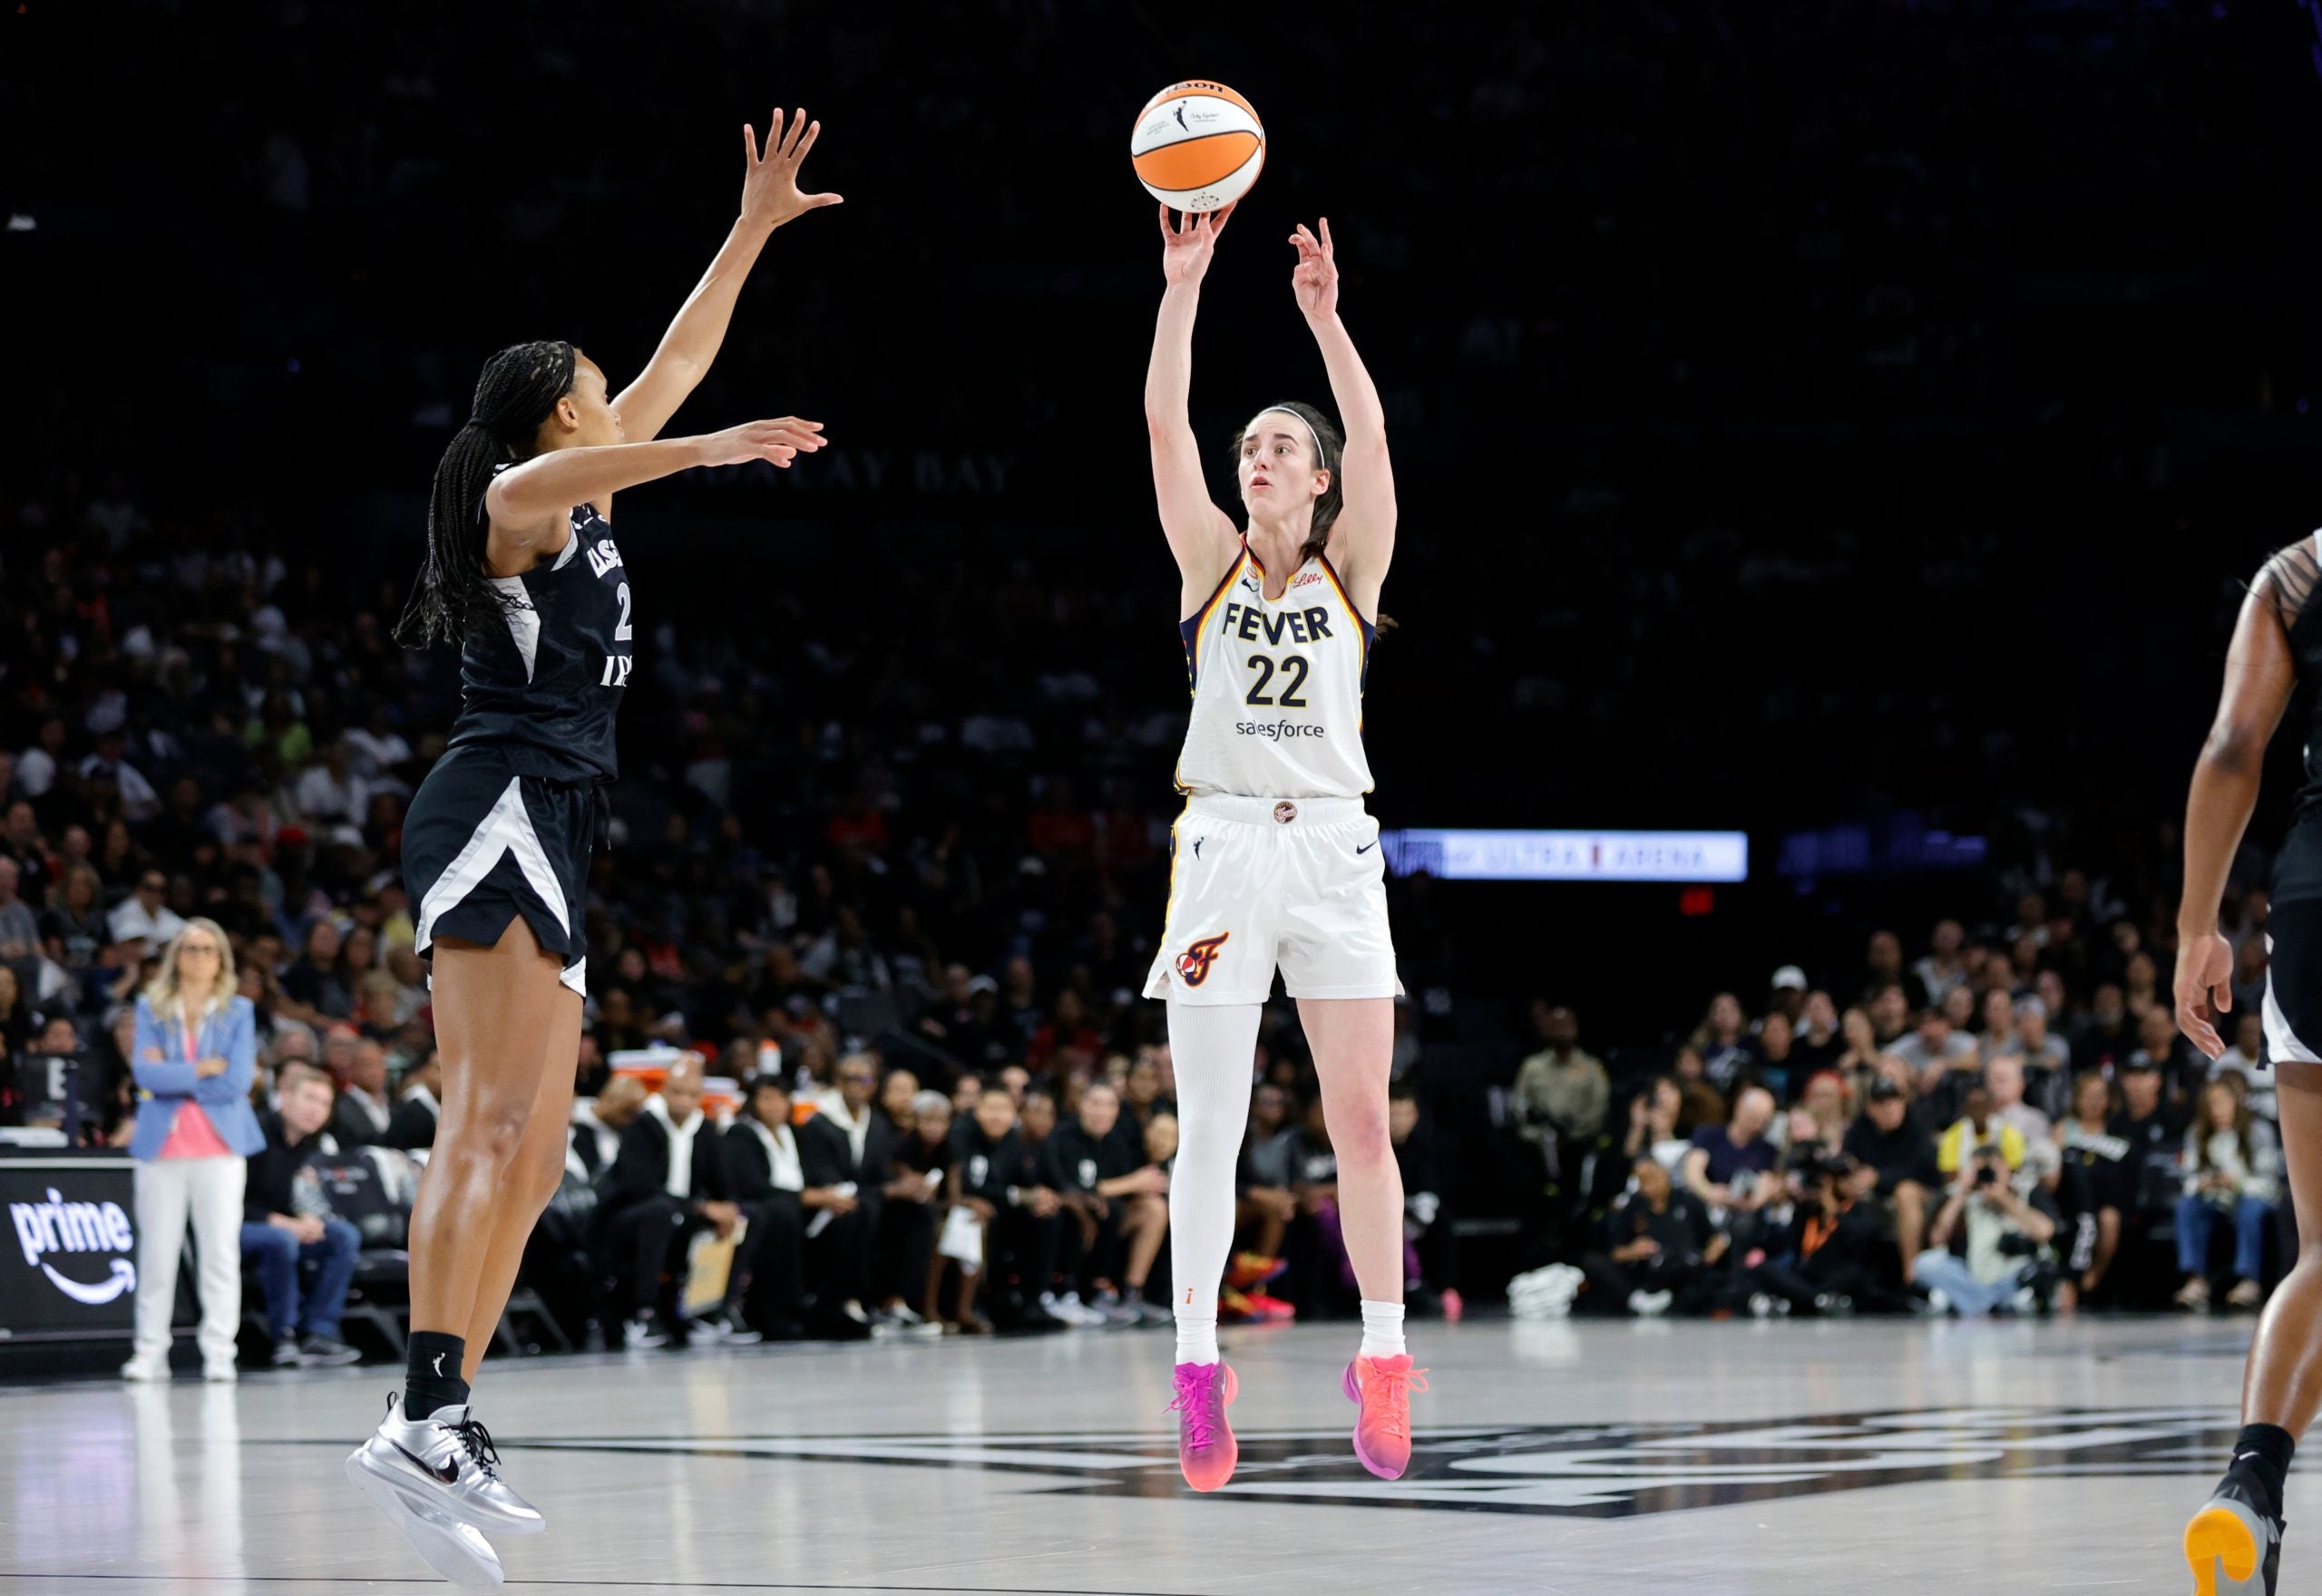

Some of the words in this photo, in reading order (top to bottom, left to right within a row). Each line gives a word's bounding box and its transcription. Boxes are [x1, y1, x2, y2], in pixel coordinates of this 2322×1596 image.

[1293, 572, 1323, 589] Lilly
[1222, 602, 1334, 647] FEVER
[600, 656, 632, 686] IP
[1245, 654, 1309, 708] 22
[1235, 719, 1324, 742] salesforce
[9, 1187, 133, 1266] prime
